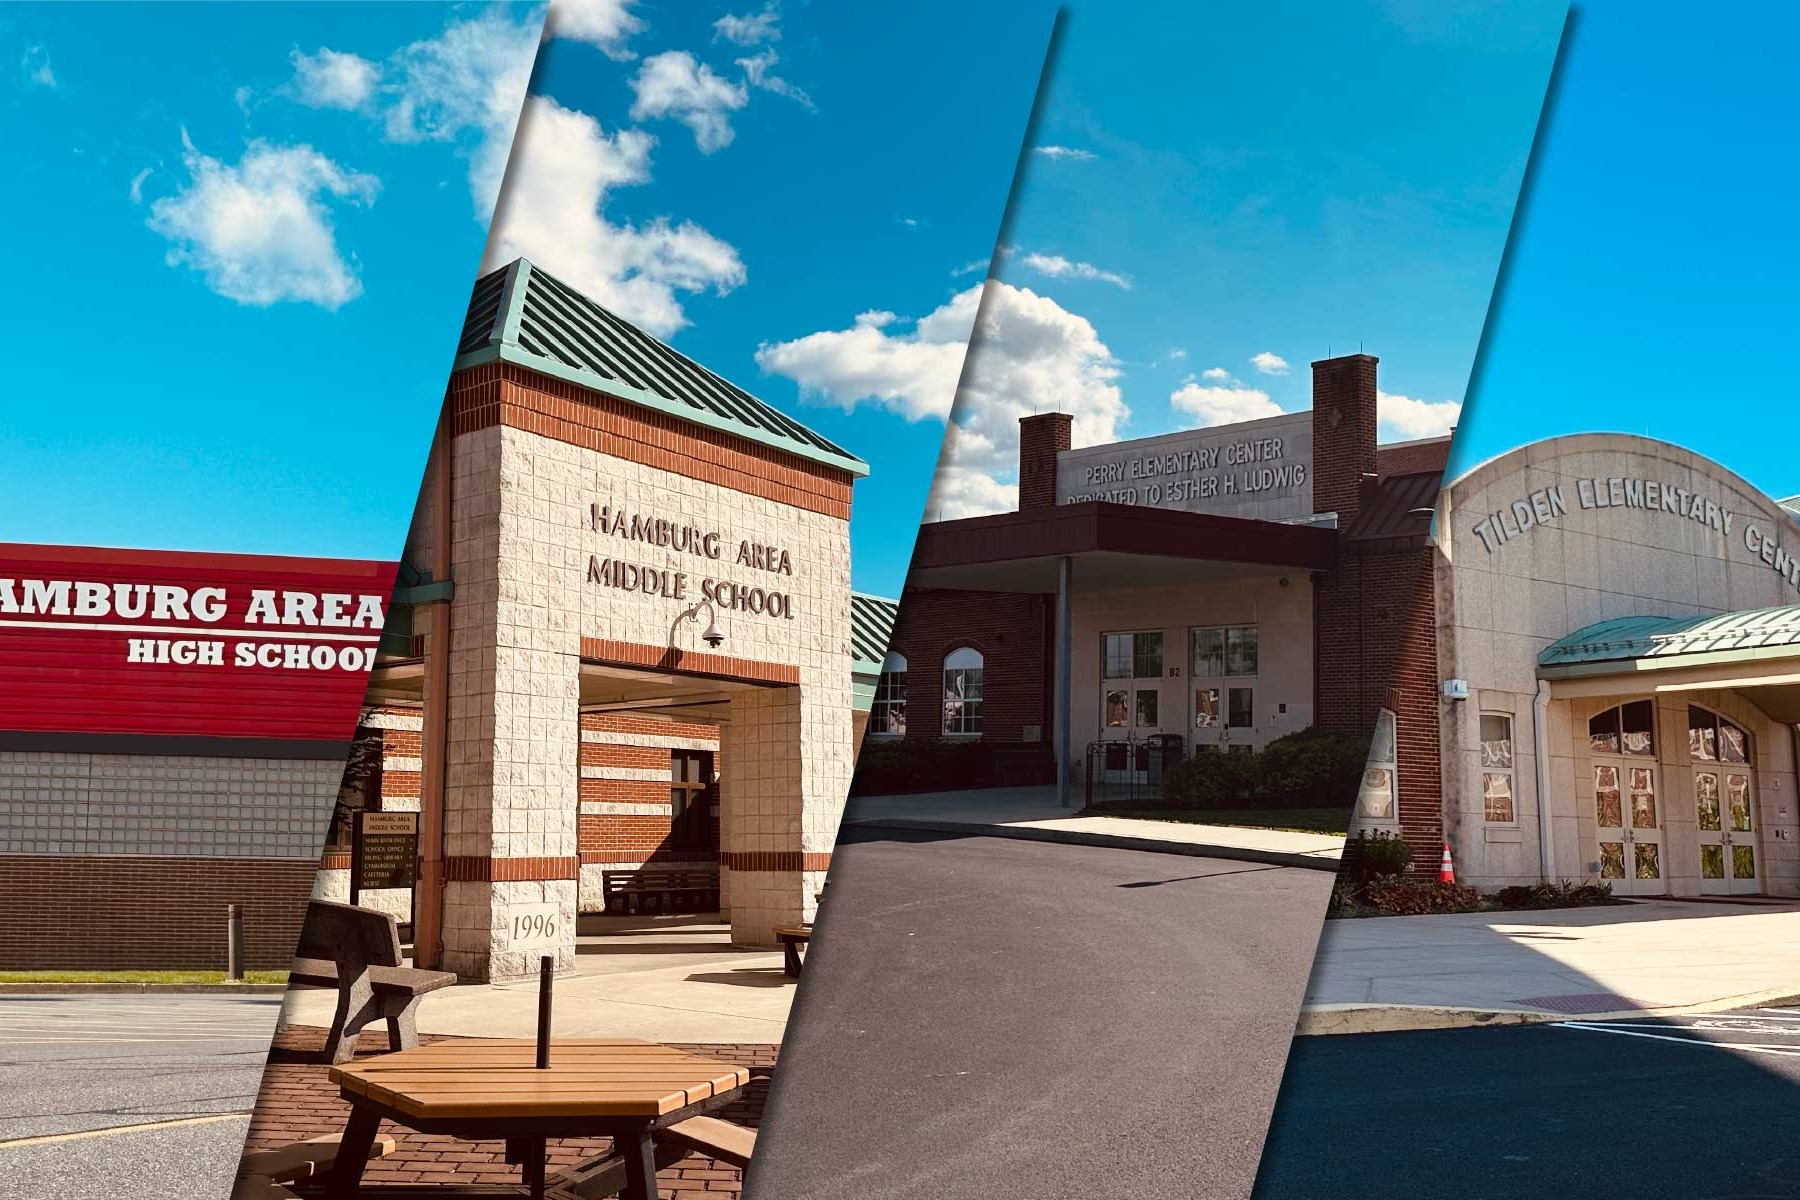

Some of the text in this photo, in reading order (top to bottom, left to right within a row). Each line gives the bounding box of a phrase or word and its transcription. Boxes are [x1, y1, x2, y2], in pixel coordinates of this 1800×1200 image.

[1085, 437, 1283, 486] PERRY ELEMENTARY CENTER
[1142, 484, 1163, 505] TO
[1166, 476, 1218, 501] ESTHER
[1224, 474, 1239, 495] H.
[1244, 464, 1306, 492] LUDWIG
[590, 503, 793, 576] HAMBURG AREA
[1473, 477, 1800, 594] TILDEN ELEMENTARY CENT
[245, 590, 385, 629] AREA
[587, 554, 795, 620] MIDDLE SCHOOL
[127, 638, 225, 666] HIGH
[513, 913, 556, 940] 1996
